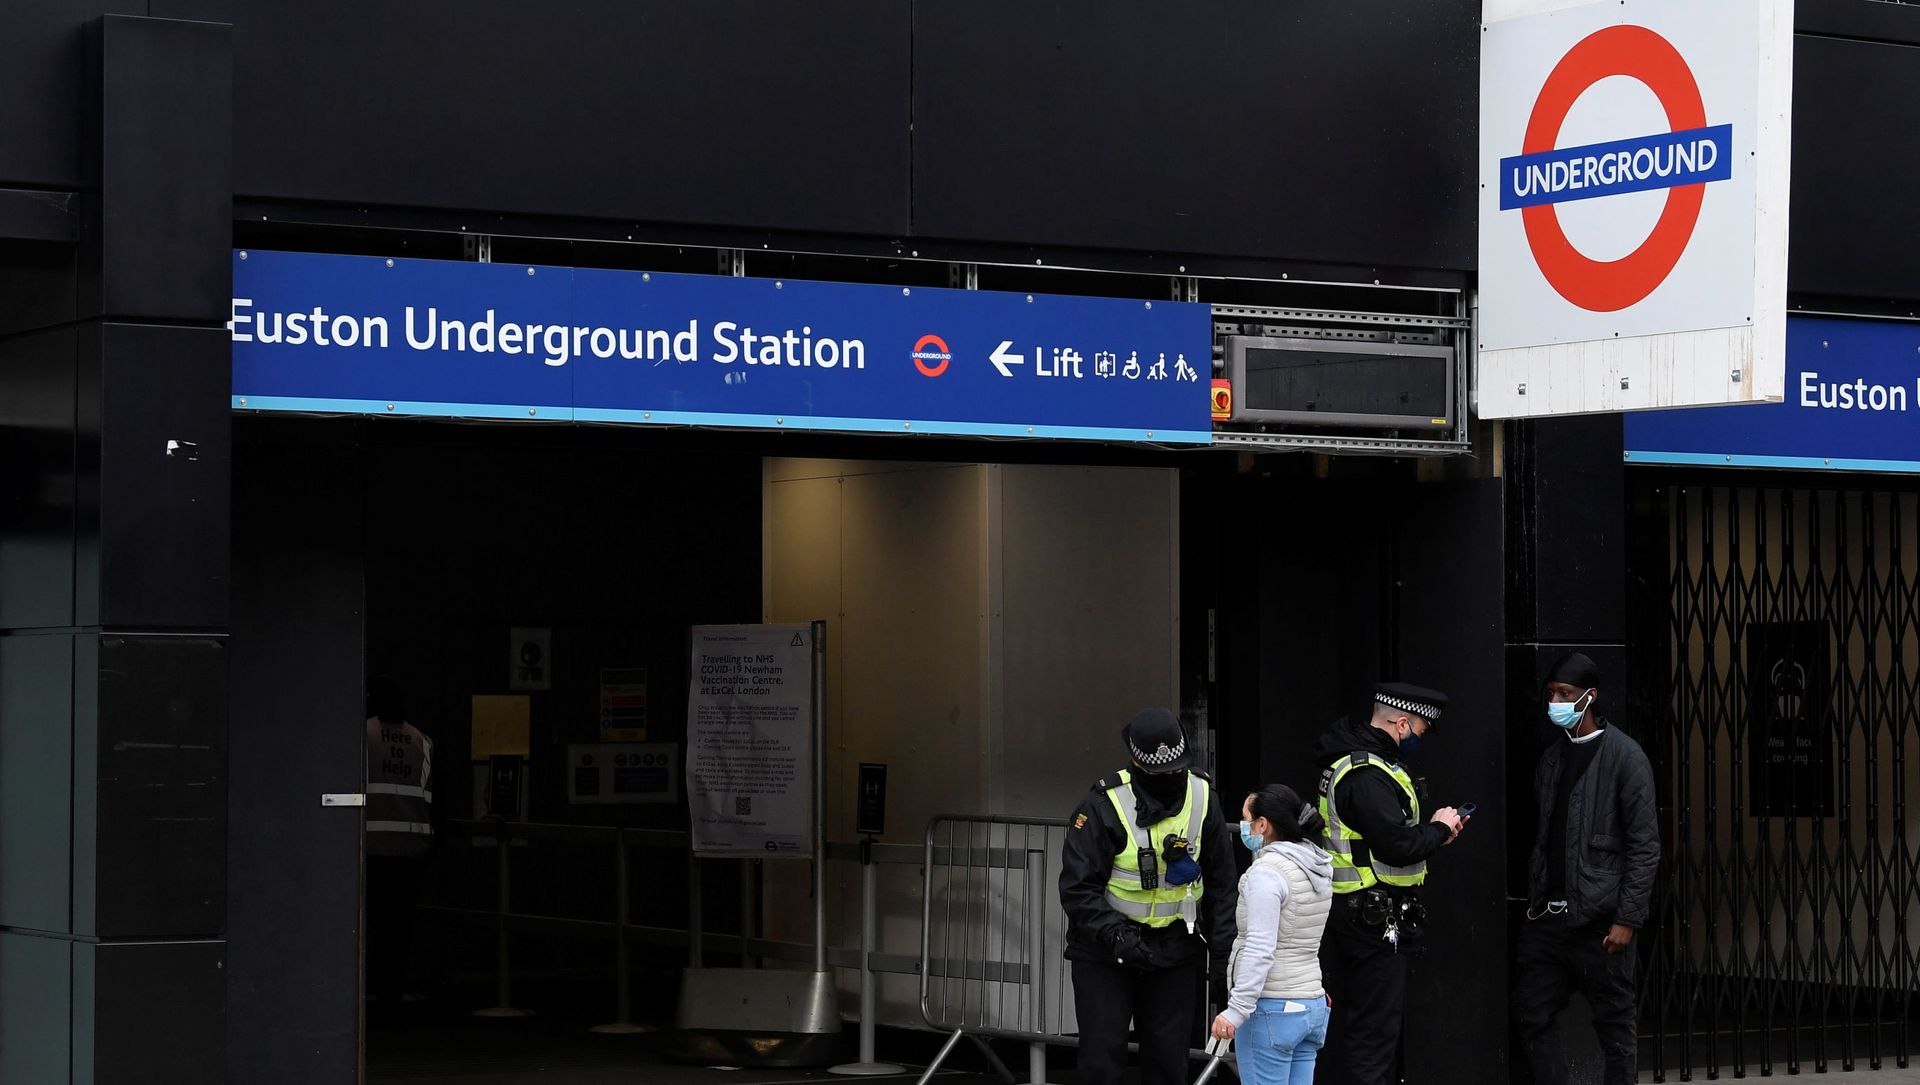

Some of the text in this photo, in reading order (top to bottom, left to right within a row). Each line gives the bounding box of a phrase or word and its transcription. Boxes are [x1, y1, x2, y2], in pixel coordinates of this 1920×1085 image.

[1513, 139, 1718, 197] UNDERGROUND
[227, 298, 865, 369] Euston Underground Station
[911, 352, 952, 360] UNDERGROUND
[1036, 346, 1084, 378] Lift
[1800, 371, 1907, 411] Euston
[702, 654, 742, 665] Travelling
[755, 655, 775, 663] NHS
[701, 665, 783, 674] COVID-19 Newham
[701, 675, 750, 685] Vaccination
[700, 687, 710, 695] at
[737, 687, 770, 695] London
[381, 729, 412, 744] Here
[390, 747, 404, 758] to
[382, 759, 412, 779] Help
